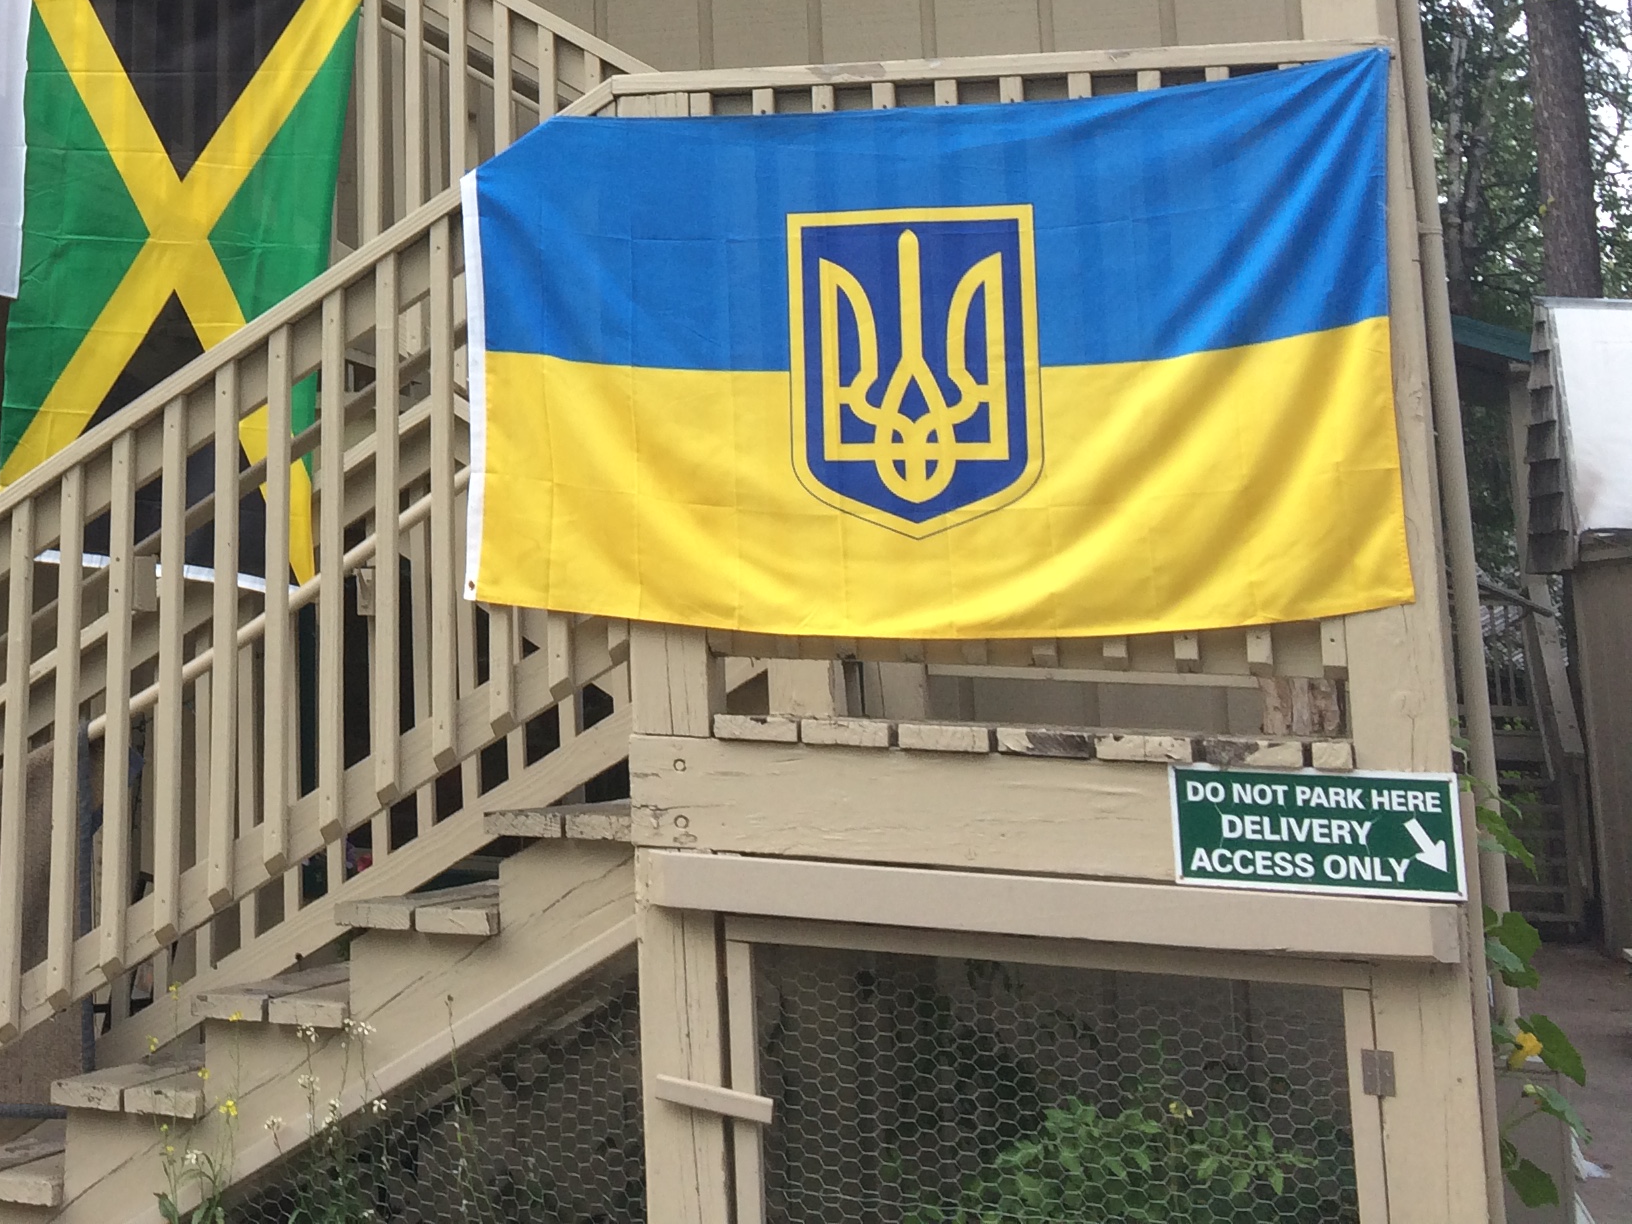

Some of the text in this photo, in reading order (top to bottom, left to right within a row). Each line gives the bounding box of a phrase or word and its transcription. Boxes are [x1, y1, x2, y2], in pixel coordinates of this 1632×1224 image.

[1186, 781, 1442, 813] DO NOT PARK HERE
[1222, 814, 1372, 845] DELIVERY
[1191, 847, 1410, 883] ACCESS ONLY
